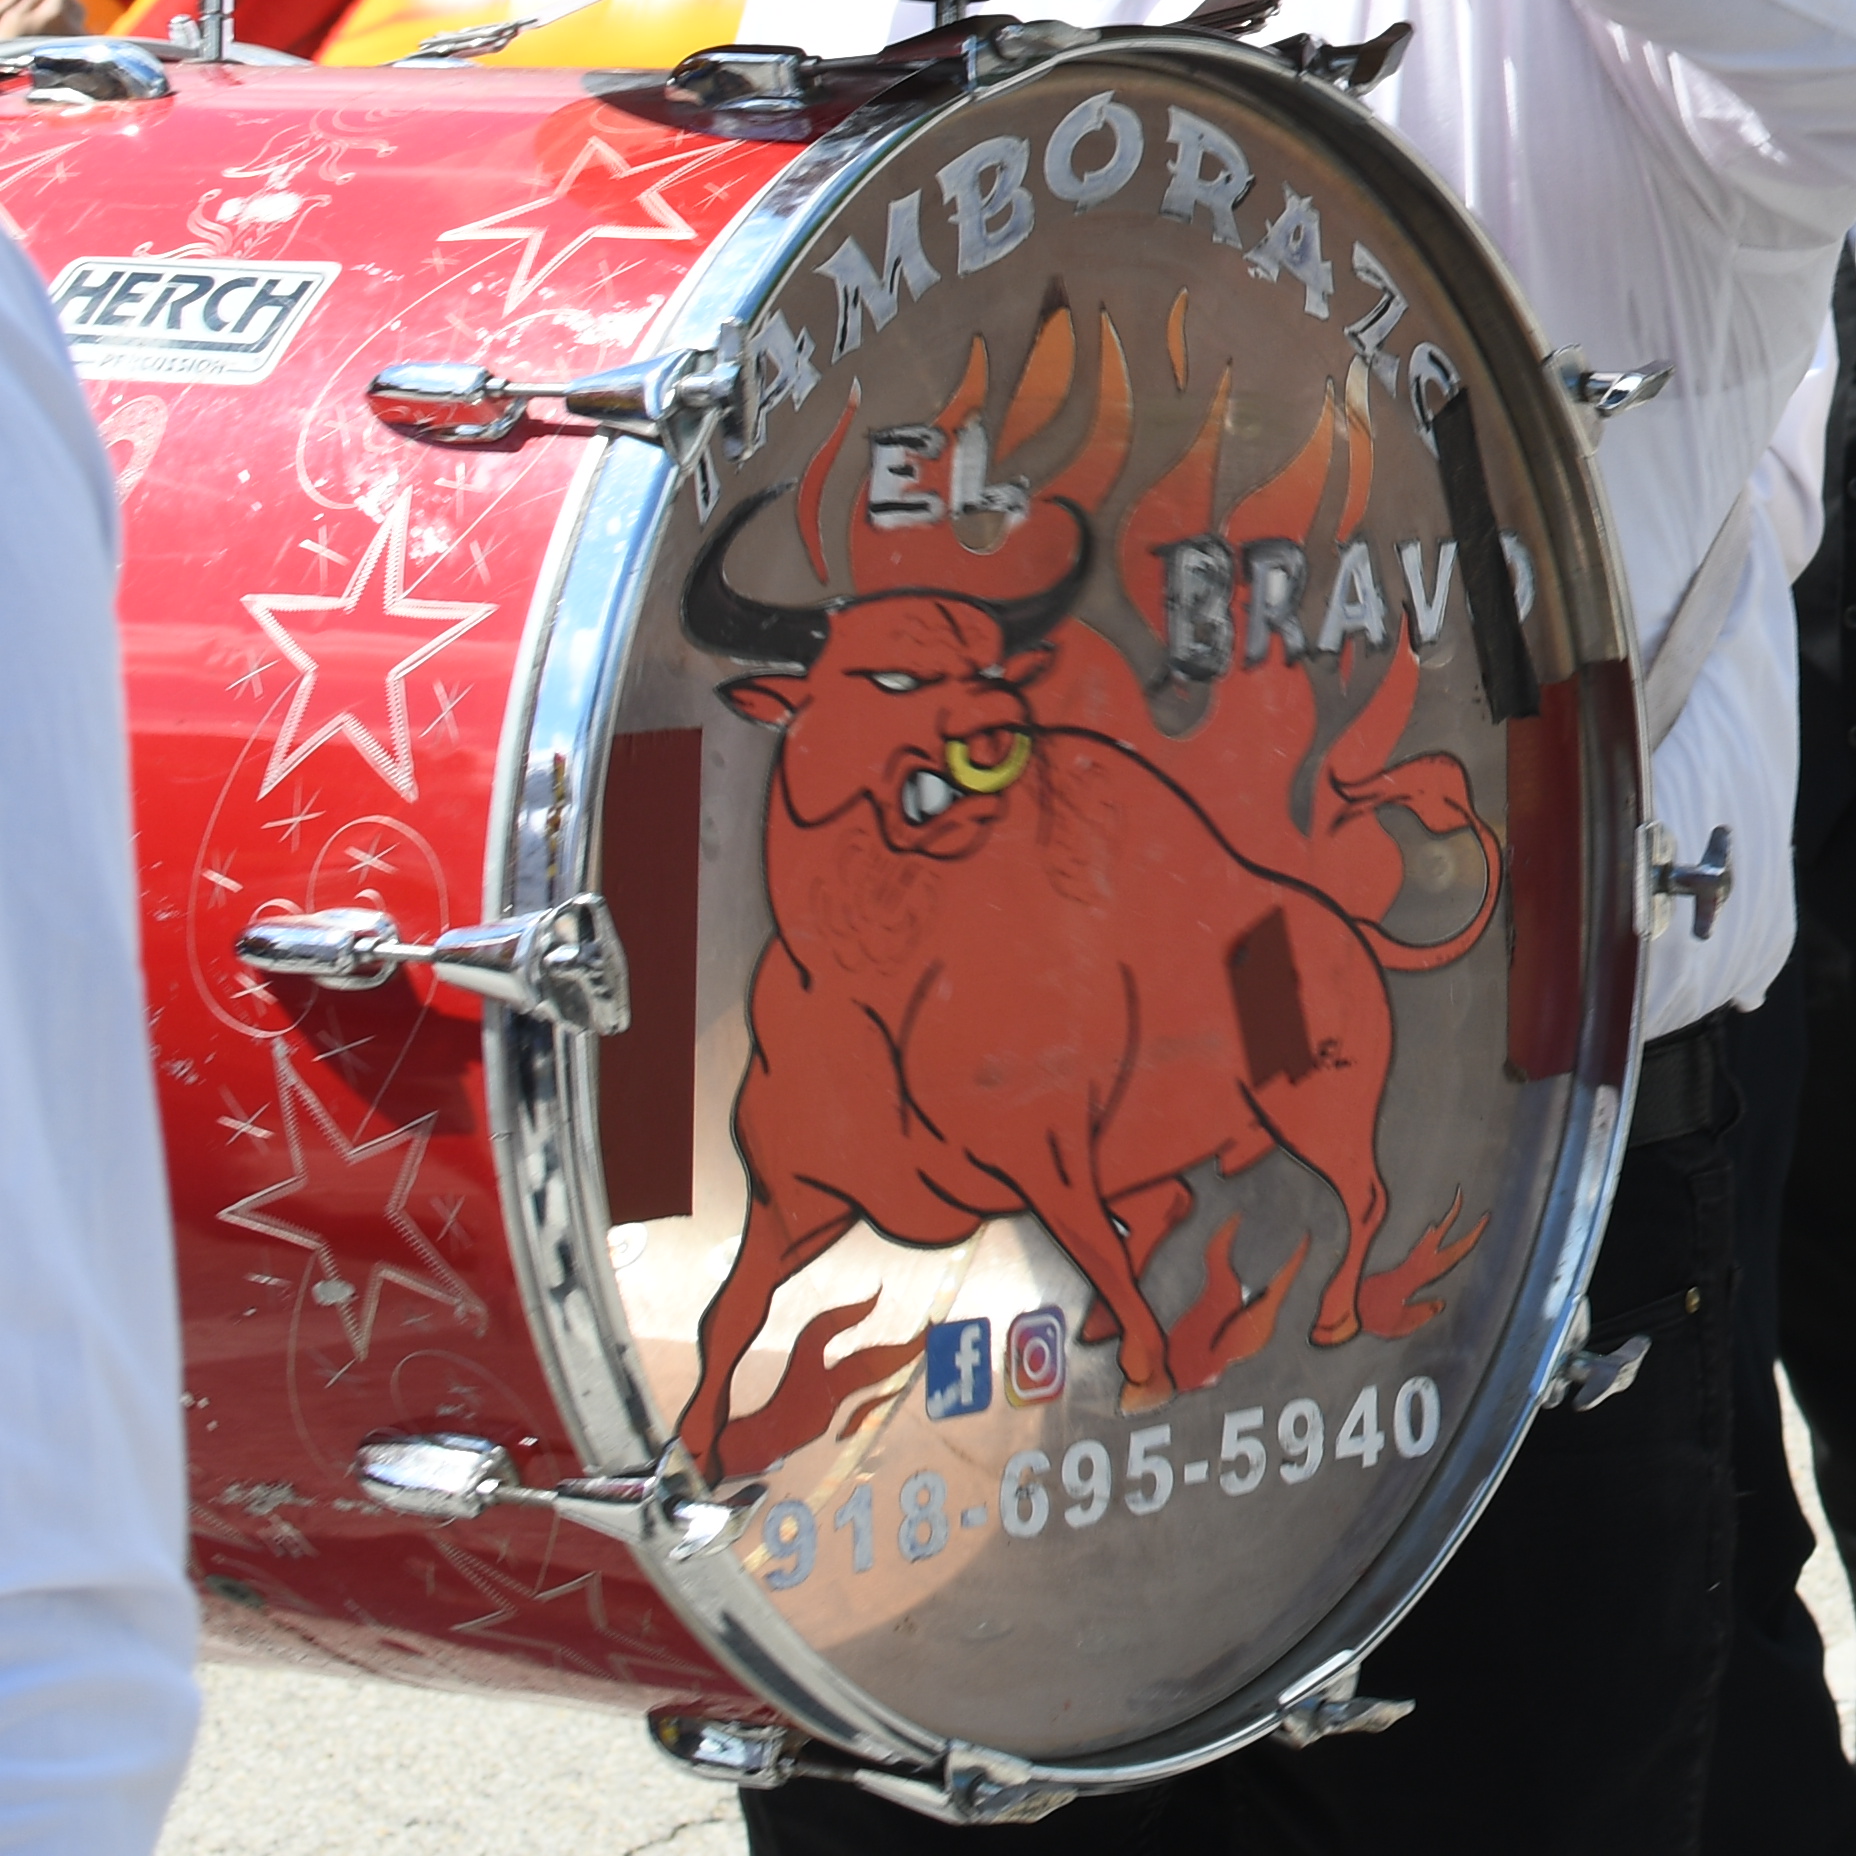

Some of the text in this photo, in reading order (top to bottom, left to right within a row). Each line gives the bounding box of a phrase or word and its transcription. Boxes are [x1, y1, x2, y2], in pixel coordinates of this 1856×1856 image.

[54, 269, 314, 334] HERCH
[868, 418, 1030, 530] EL
[763, 1375, 1441, 1591] 918-695-5940
